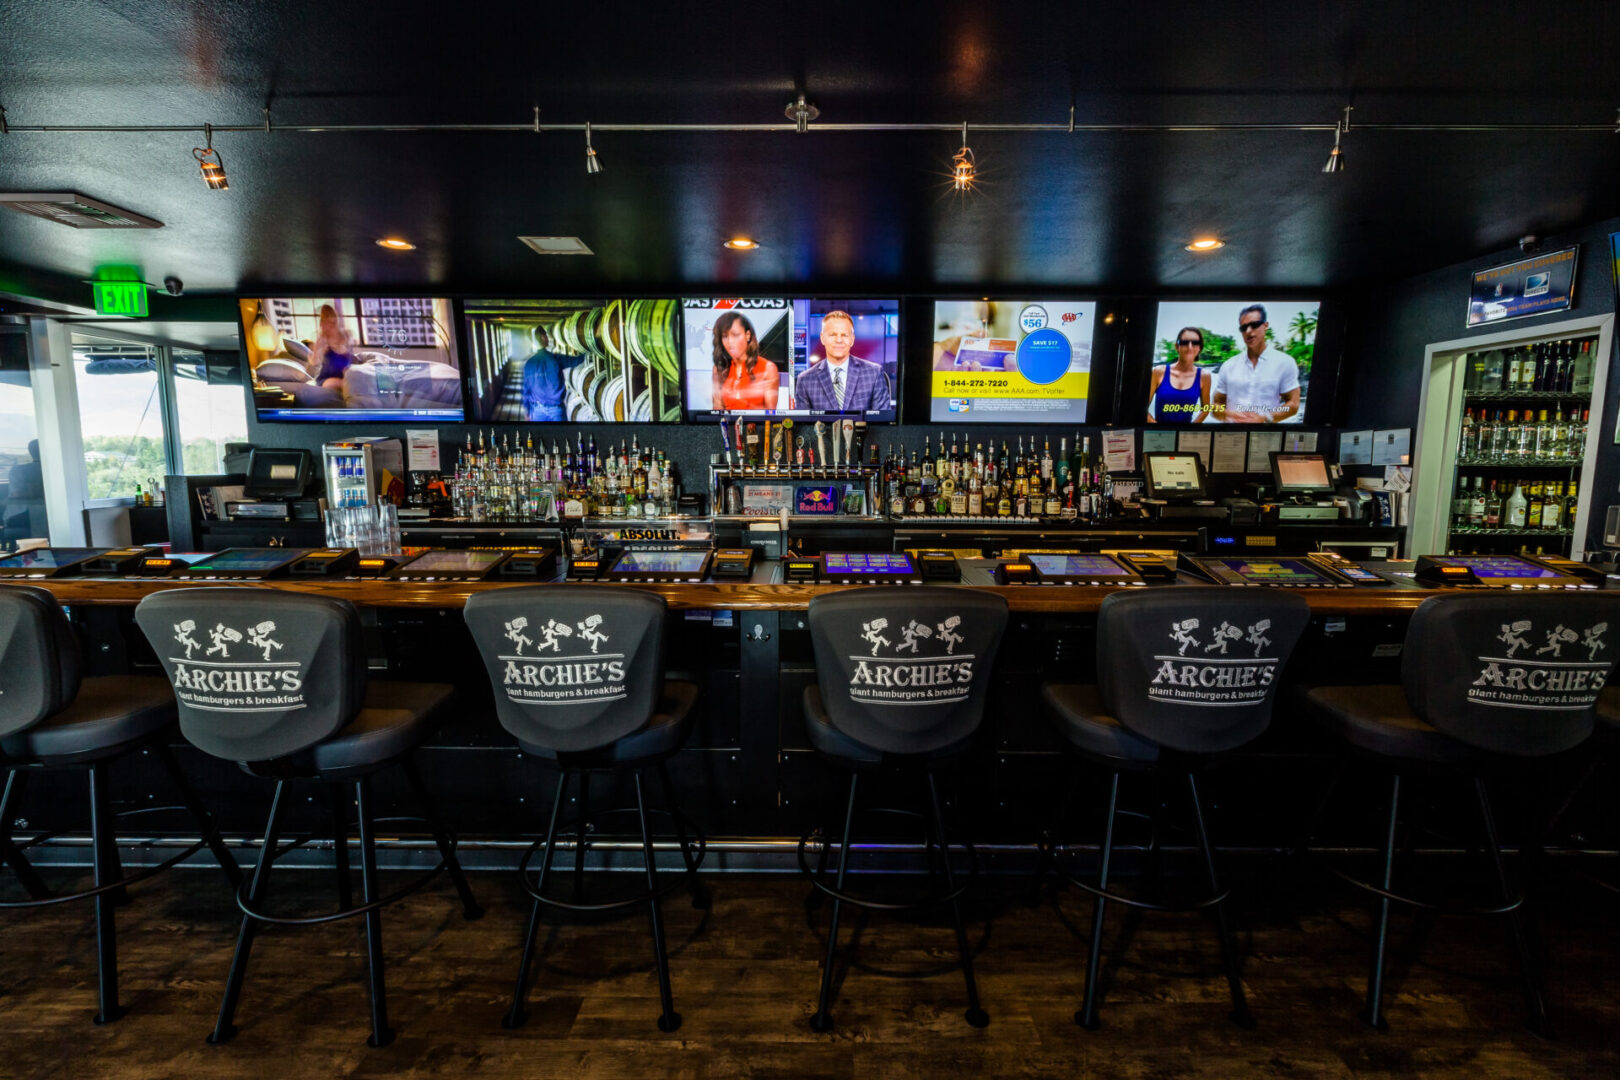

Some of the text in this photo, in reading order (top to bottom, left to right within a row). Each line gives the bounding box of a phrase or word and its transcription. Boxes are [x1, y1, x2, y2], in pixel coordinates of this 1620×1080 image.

[1534, 251, 1574, 268] COVERED
[101, 286, 140, 313] EXIT
[1024, 319, 1042, 328] $56
[388, 330, 408, 342] 76
[800, 502, 833, 511] Red Bull
[174, 664, 302, 693] ARCHIE'S
[504, 661, 626, 687] ARCHIE'S
[850, 661, 973, 688] ARCHIE'S
[1152, 661, 1275, 688] ARCHIE'S
[1472, 663, 1608, 691] ARCHIE'S
[194, 693, 245, 706] hamburgers
[255, 694, 304, 704] breakfast
[523, 687, 574, 699] hamburgers
[575, 688, 583, 696] &
[584, 685, 626, 696] breakfast
[873, 688, 925, 700] hamburgers
[927, 690, 934, 698] &
[1149, 687, 1173, 697] giant
[1175, 689, 1229, 701] hamburgers
[1231, 691, 1237, 699] &
[1468, 688, 1496, 698] giant
[1500, 691, 1559, 704] hamburgers
[1561, 695, 1568, 703] &
